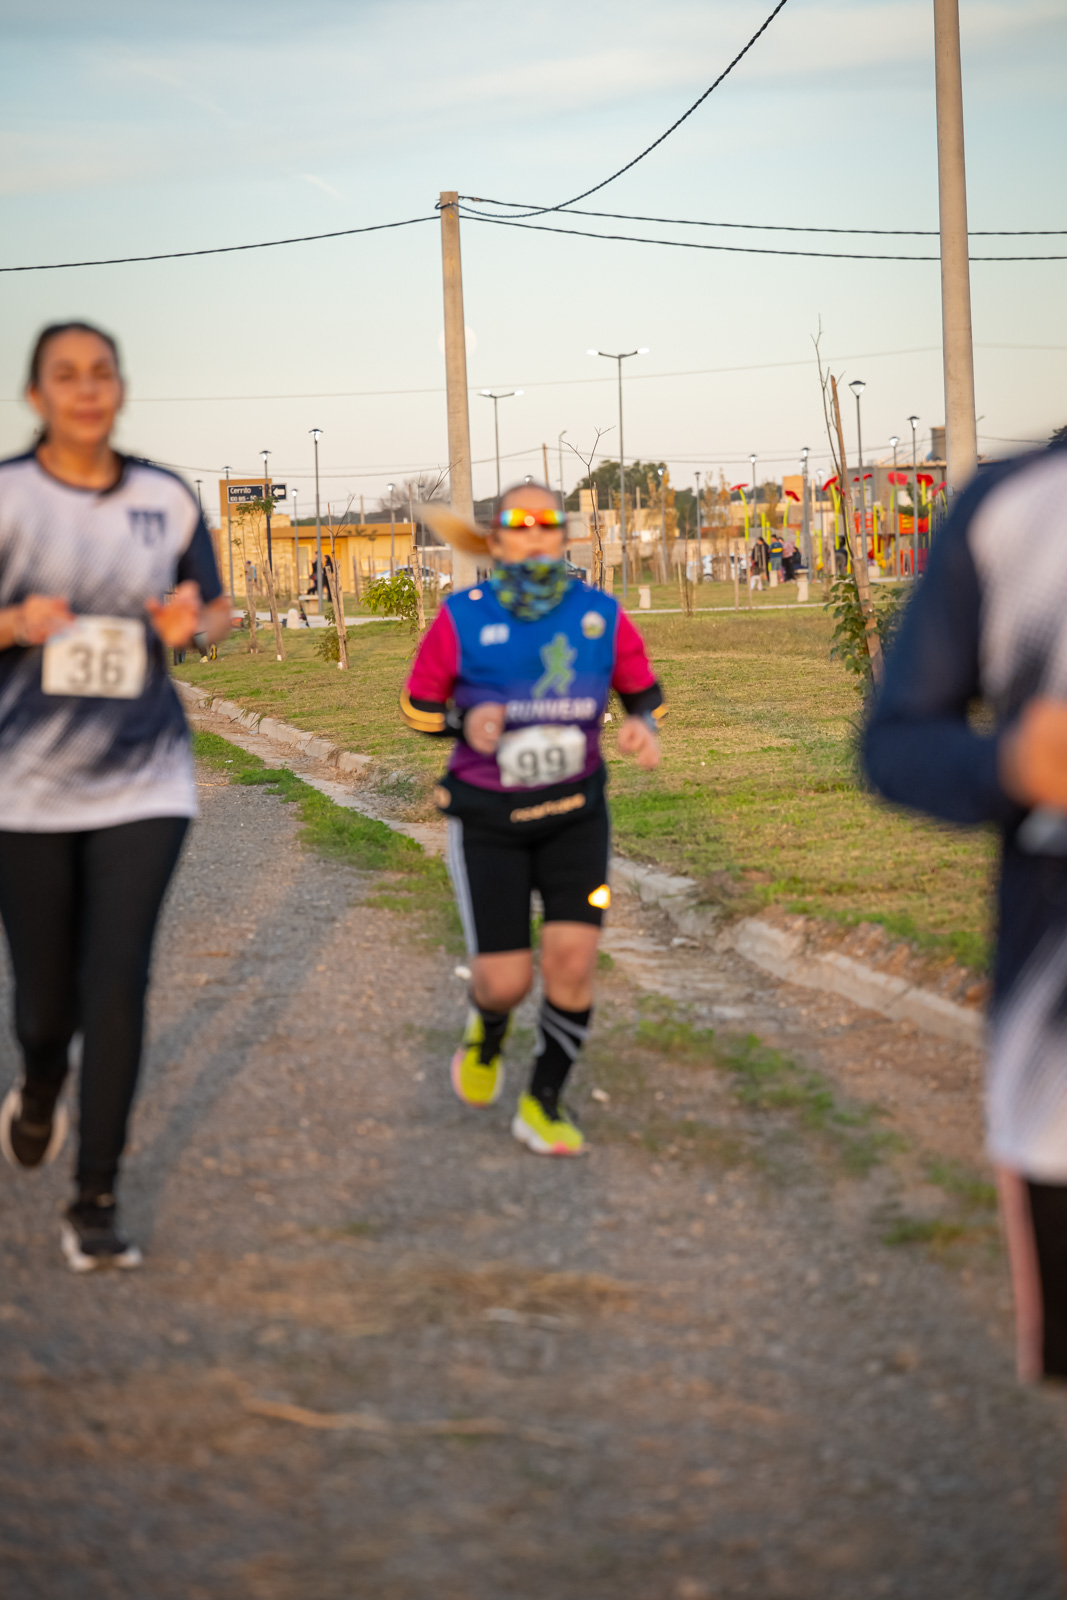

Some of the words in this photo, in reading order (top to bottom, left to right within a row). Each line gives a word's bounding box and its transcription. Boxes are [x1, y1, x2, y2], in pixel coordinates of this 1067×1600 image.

[230, 487, 251, 495] Cerrito
[67, 643, 126, 691] 36
[516, 746, 567, 784] 99
